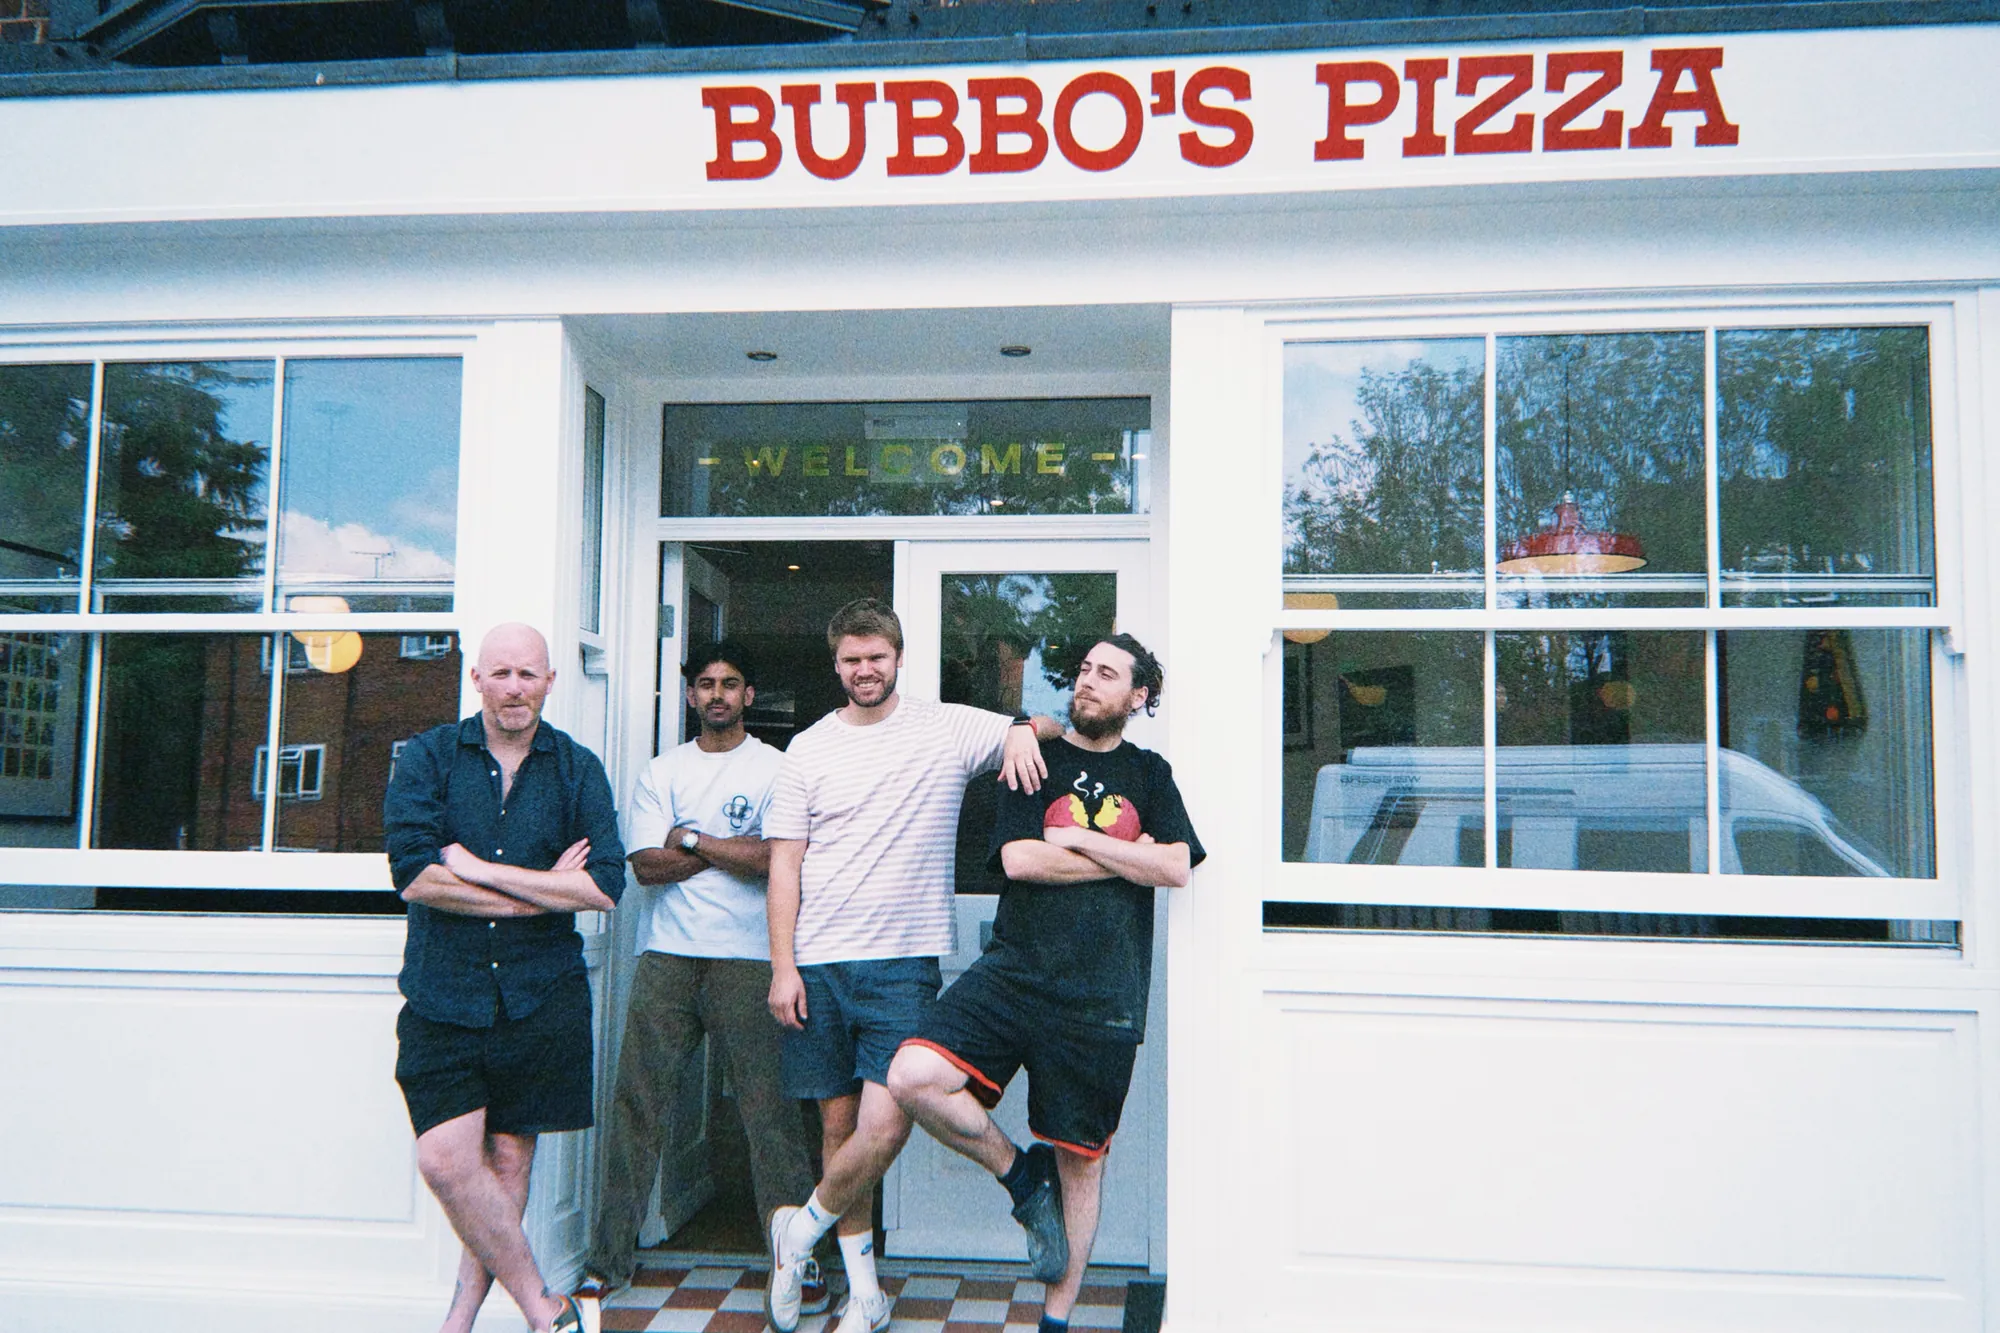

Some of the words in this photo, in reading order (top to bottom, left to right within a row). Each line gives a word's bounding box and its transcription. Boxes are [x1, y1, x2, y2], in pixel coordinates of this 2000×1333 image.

[702, 66, 1254, 181] BUBBO'S
[1314, 47, 1739, 161] PIZZA
[743, 443, 1065, 476] WELCOME
